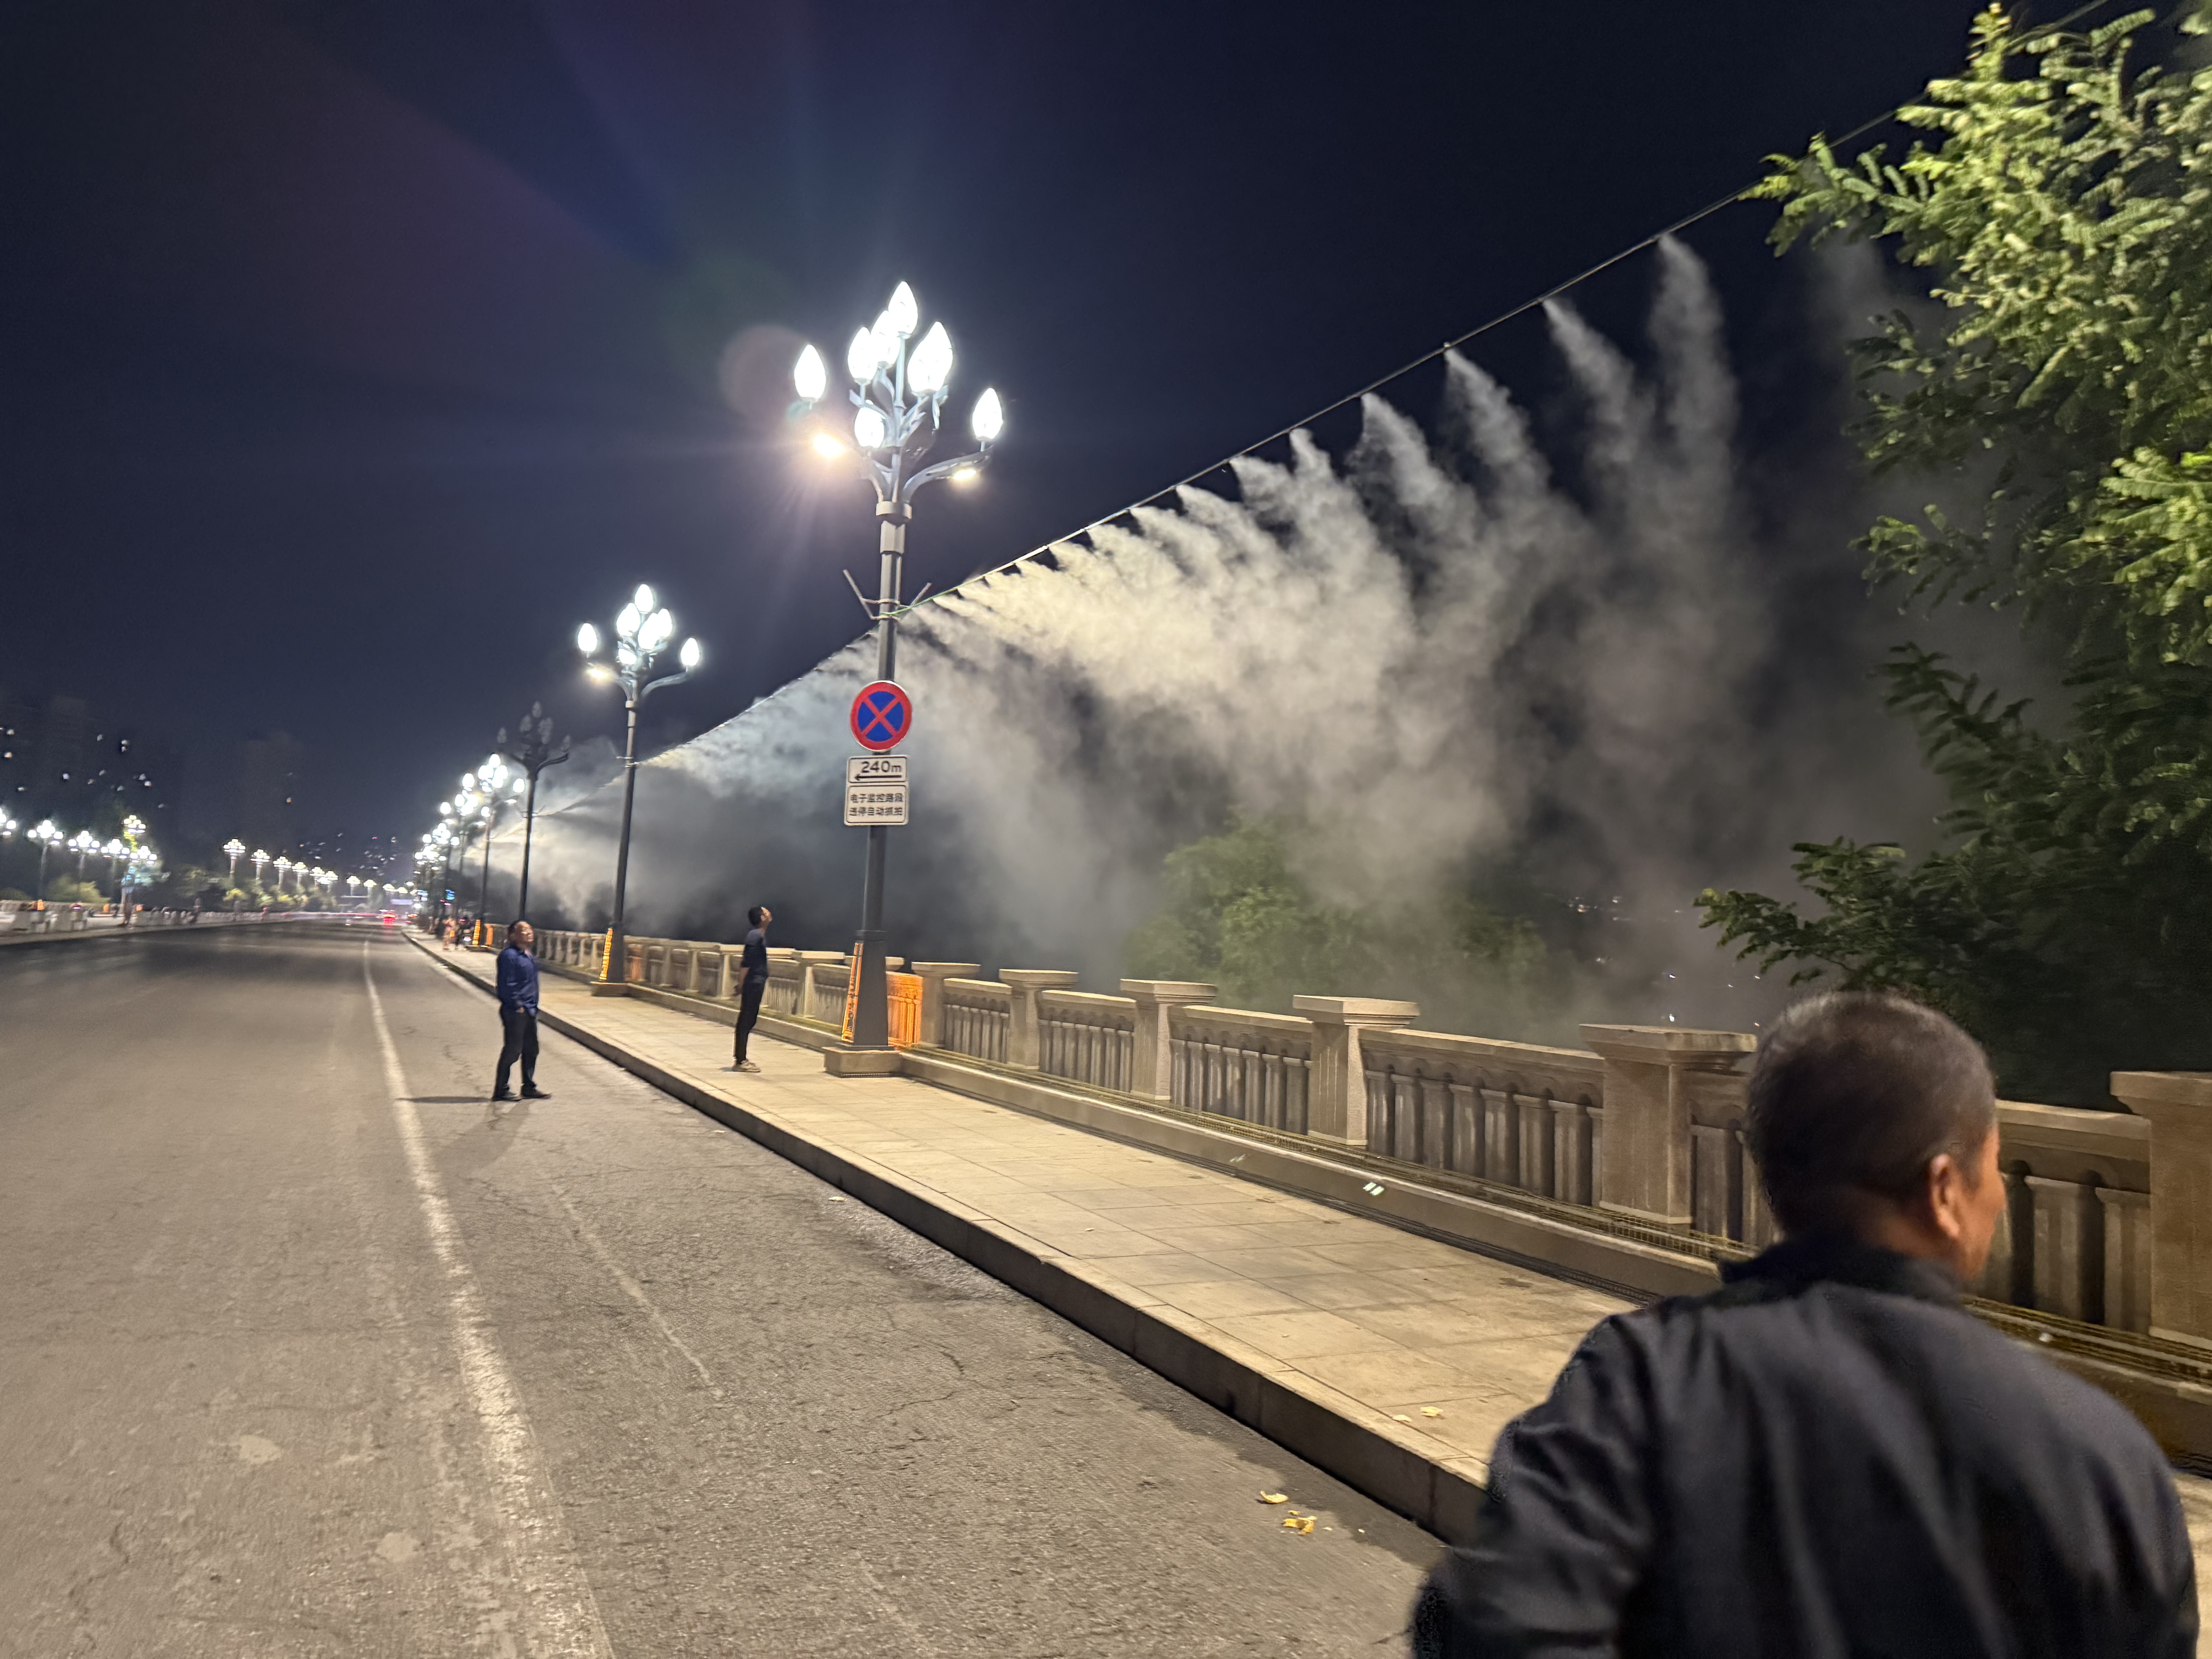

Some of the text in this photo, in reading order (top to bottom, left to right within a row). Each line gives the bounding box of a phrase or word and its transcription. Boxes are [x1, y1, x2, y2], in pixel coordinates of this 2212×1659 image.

[861, 761, 902, 773] 240m
[850, 793, 903, 803] 电子监控路段
